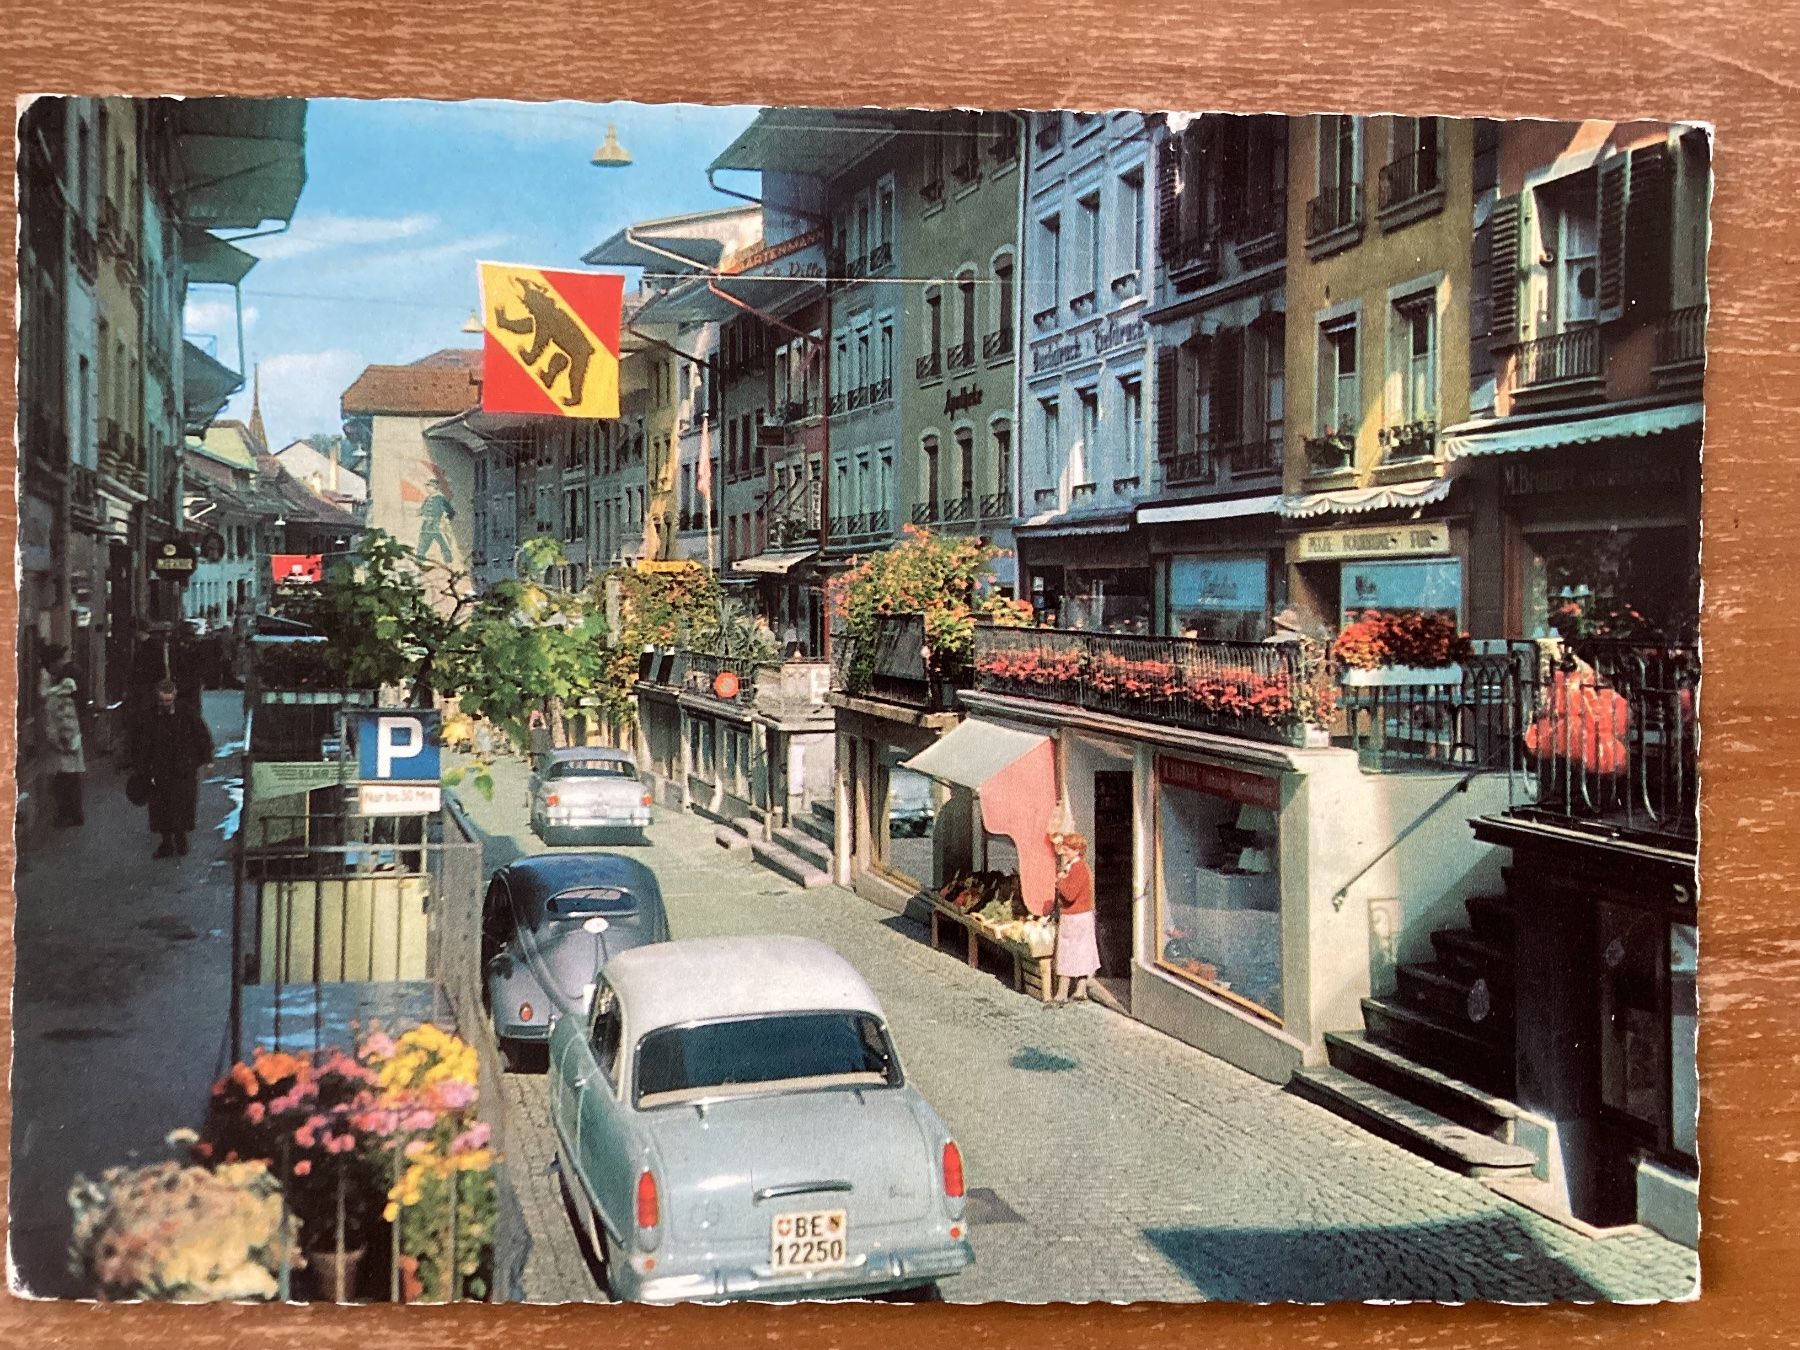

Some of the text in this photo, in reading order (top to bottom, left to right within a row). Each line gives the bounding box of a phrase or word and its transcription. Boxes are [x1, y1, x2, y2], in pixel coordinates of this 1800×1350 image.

[377, 716, 423, 778] P
[365, 791, 384, 802] Nur
[386, 790, 398, 802] bis
[400, 789, 413, 802] 30
[795, 1215, 823, 1238] BE
[775, 1239, 842, 1266] 12250
